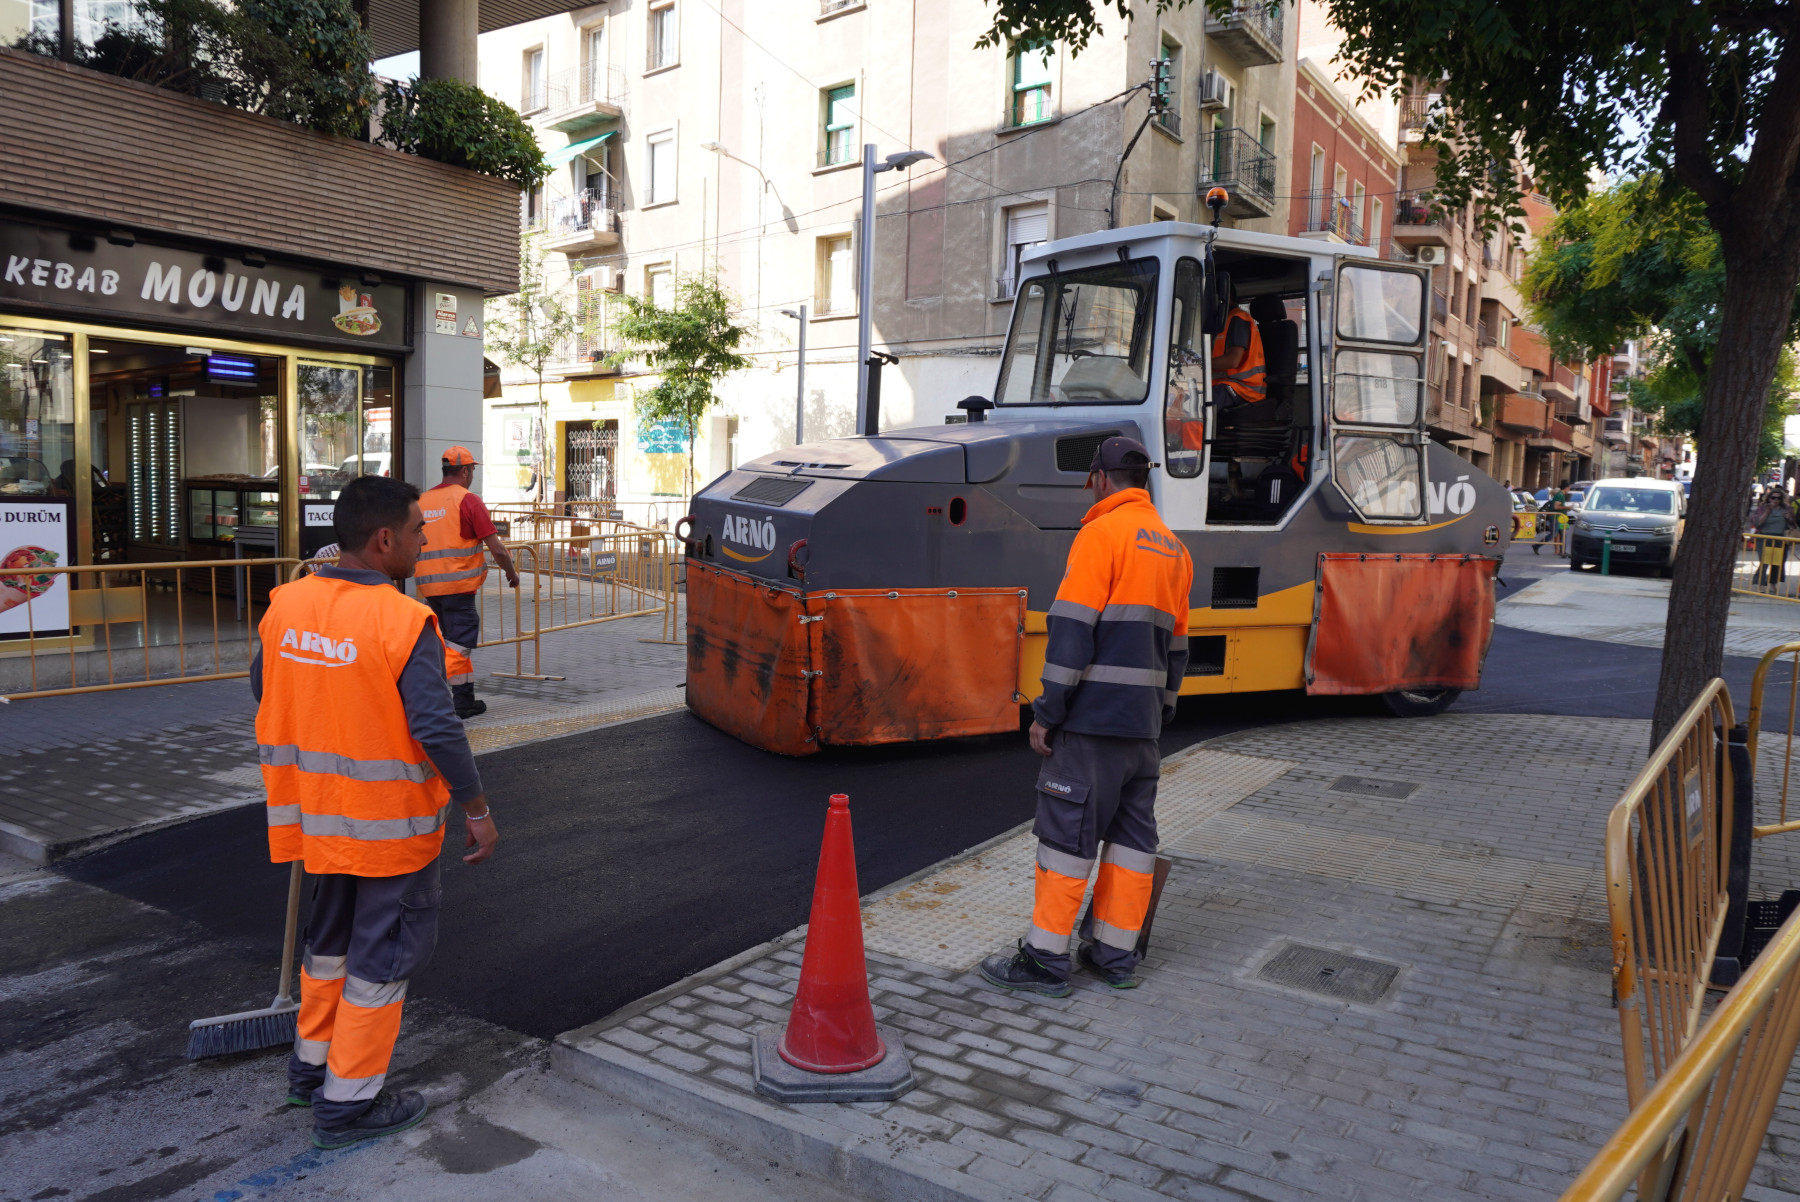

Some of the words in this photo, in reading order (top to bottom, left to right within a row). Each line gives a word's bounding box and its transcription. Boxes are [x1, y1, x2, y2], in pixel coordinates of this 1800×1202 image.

[5, 255, 119, 295] KEBAB
[141, 261, 305, 321] MOUNA
[4, 509, 61, 523] DURÜM
[423, 506, 446, 519] RNÓ
[722, 514, 776, 551] ARNÓ
[596, 556, 615, 566] ARNÓ
[280, 628, 358, 662] ARNÓ
[1044, 781, 1072, 793] ARNÓ
